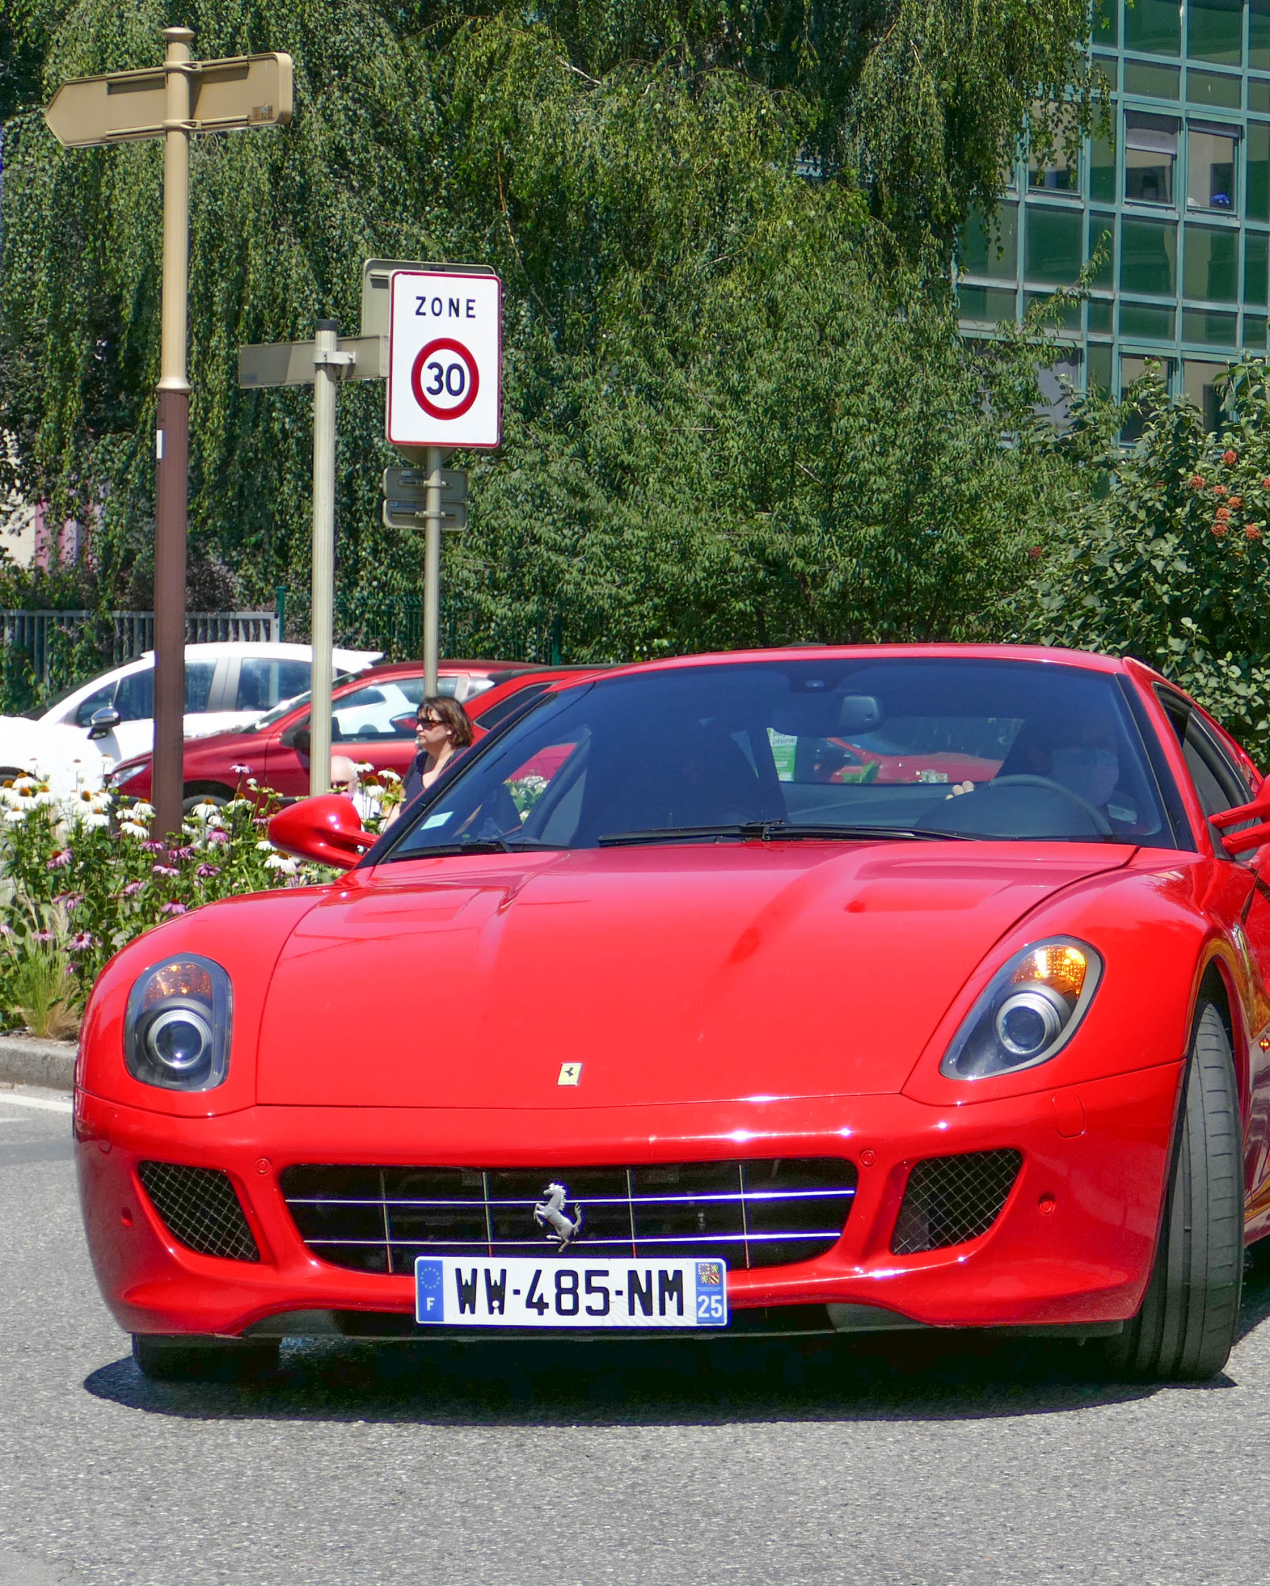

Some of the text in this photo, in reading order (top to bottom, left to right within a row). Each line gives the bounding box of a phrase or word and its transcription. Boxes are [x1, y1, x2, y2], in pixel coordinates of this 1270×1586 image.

[415, 296, 476, 318] ZONE
[426, 362, 465, 396] 30
[455, 1268, 683, 1316] WW-485-NM
[427, 1297, 436, 1311] F
[697, 1295, 723, 1318] 25
